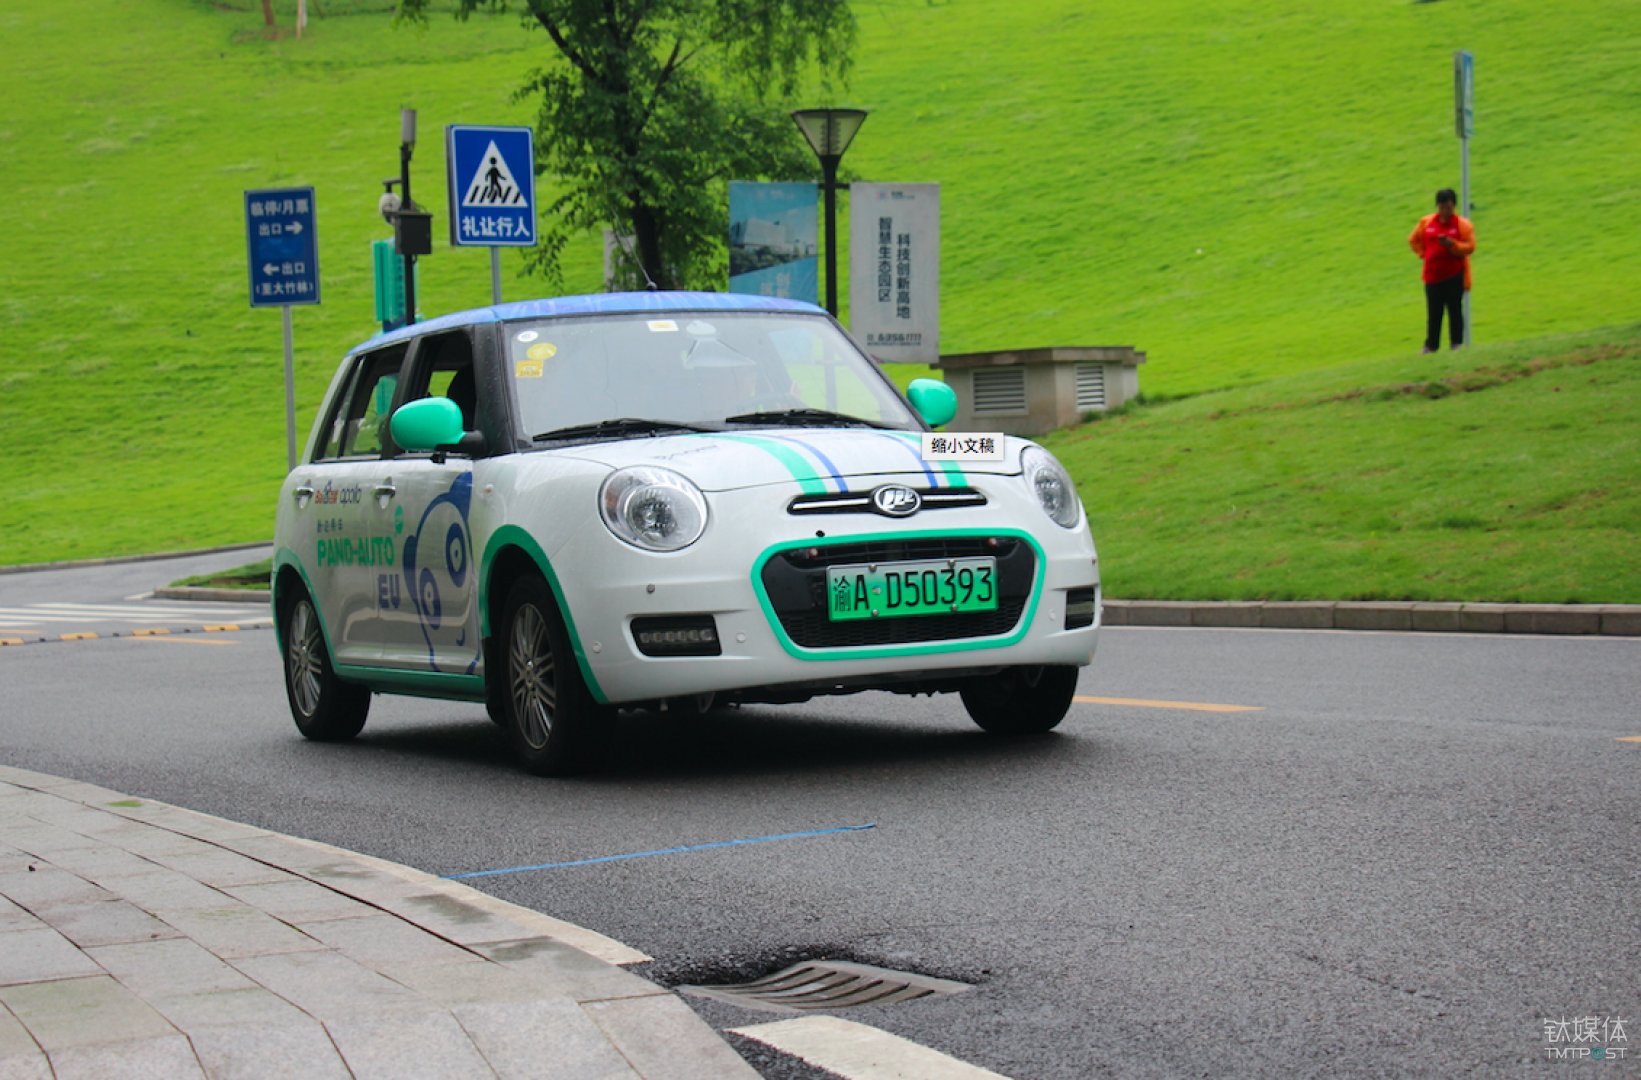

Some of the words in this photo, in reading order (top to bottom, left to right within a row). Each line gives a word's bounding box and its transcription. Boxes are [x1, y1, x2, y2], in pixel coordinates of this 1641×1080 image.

[259, 222, 282, 236] 出口
[462, 215, 531, 238] 礼让行人
[282, 261, 306, 275] 出口
[896, 233, 910, 319] 科技创新高地
